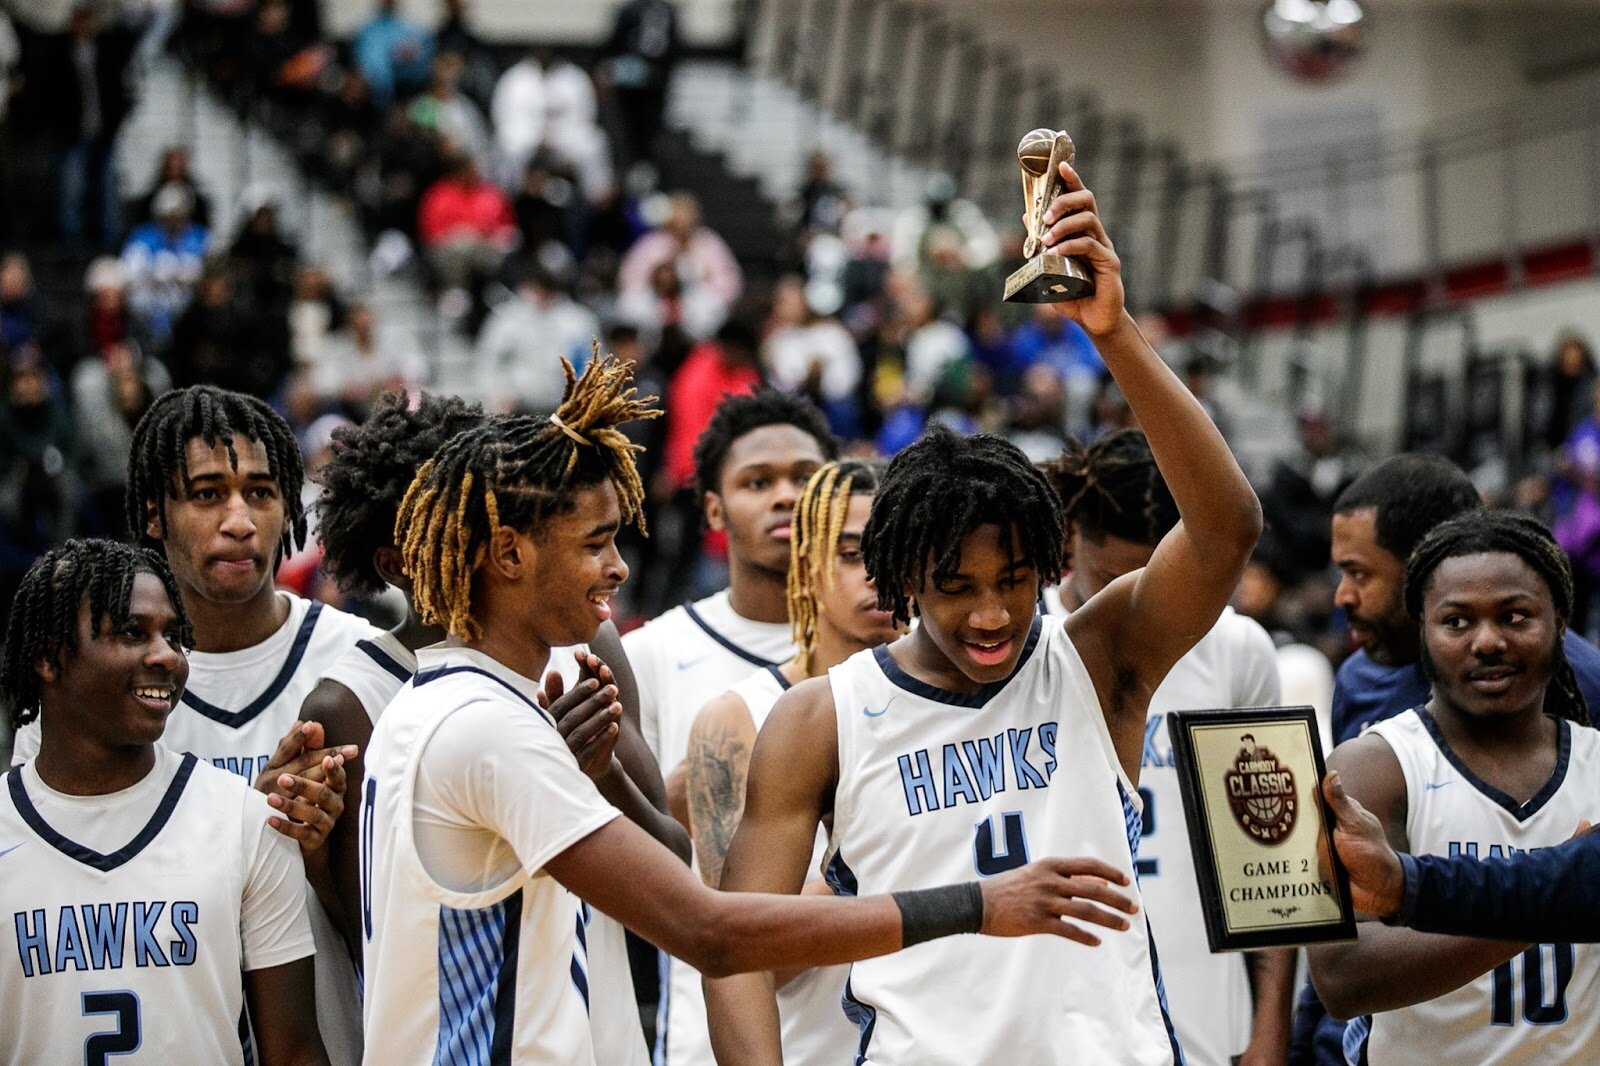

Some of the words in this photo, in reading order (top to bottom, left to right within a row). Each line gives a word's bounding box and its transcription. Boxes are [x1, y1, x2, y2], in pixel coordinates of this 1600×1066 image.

[898, 721, 1058, 816] HAWKS
[1229, 772, 1293, 797] CLASSIC
[1230, 881, 1331, 902] CHAMPIONS
[1243, 860, 1291, 877] GAME
[1301, 859, 1309, 873] 2
[14, 900, 199, 978] HAWKS
[1490, 936, 1577, 1027] 10
[80, 988, 142, 1066] 2
